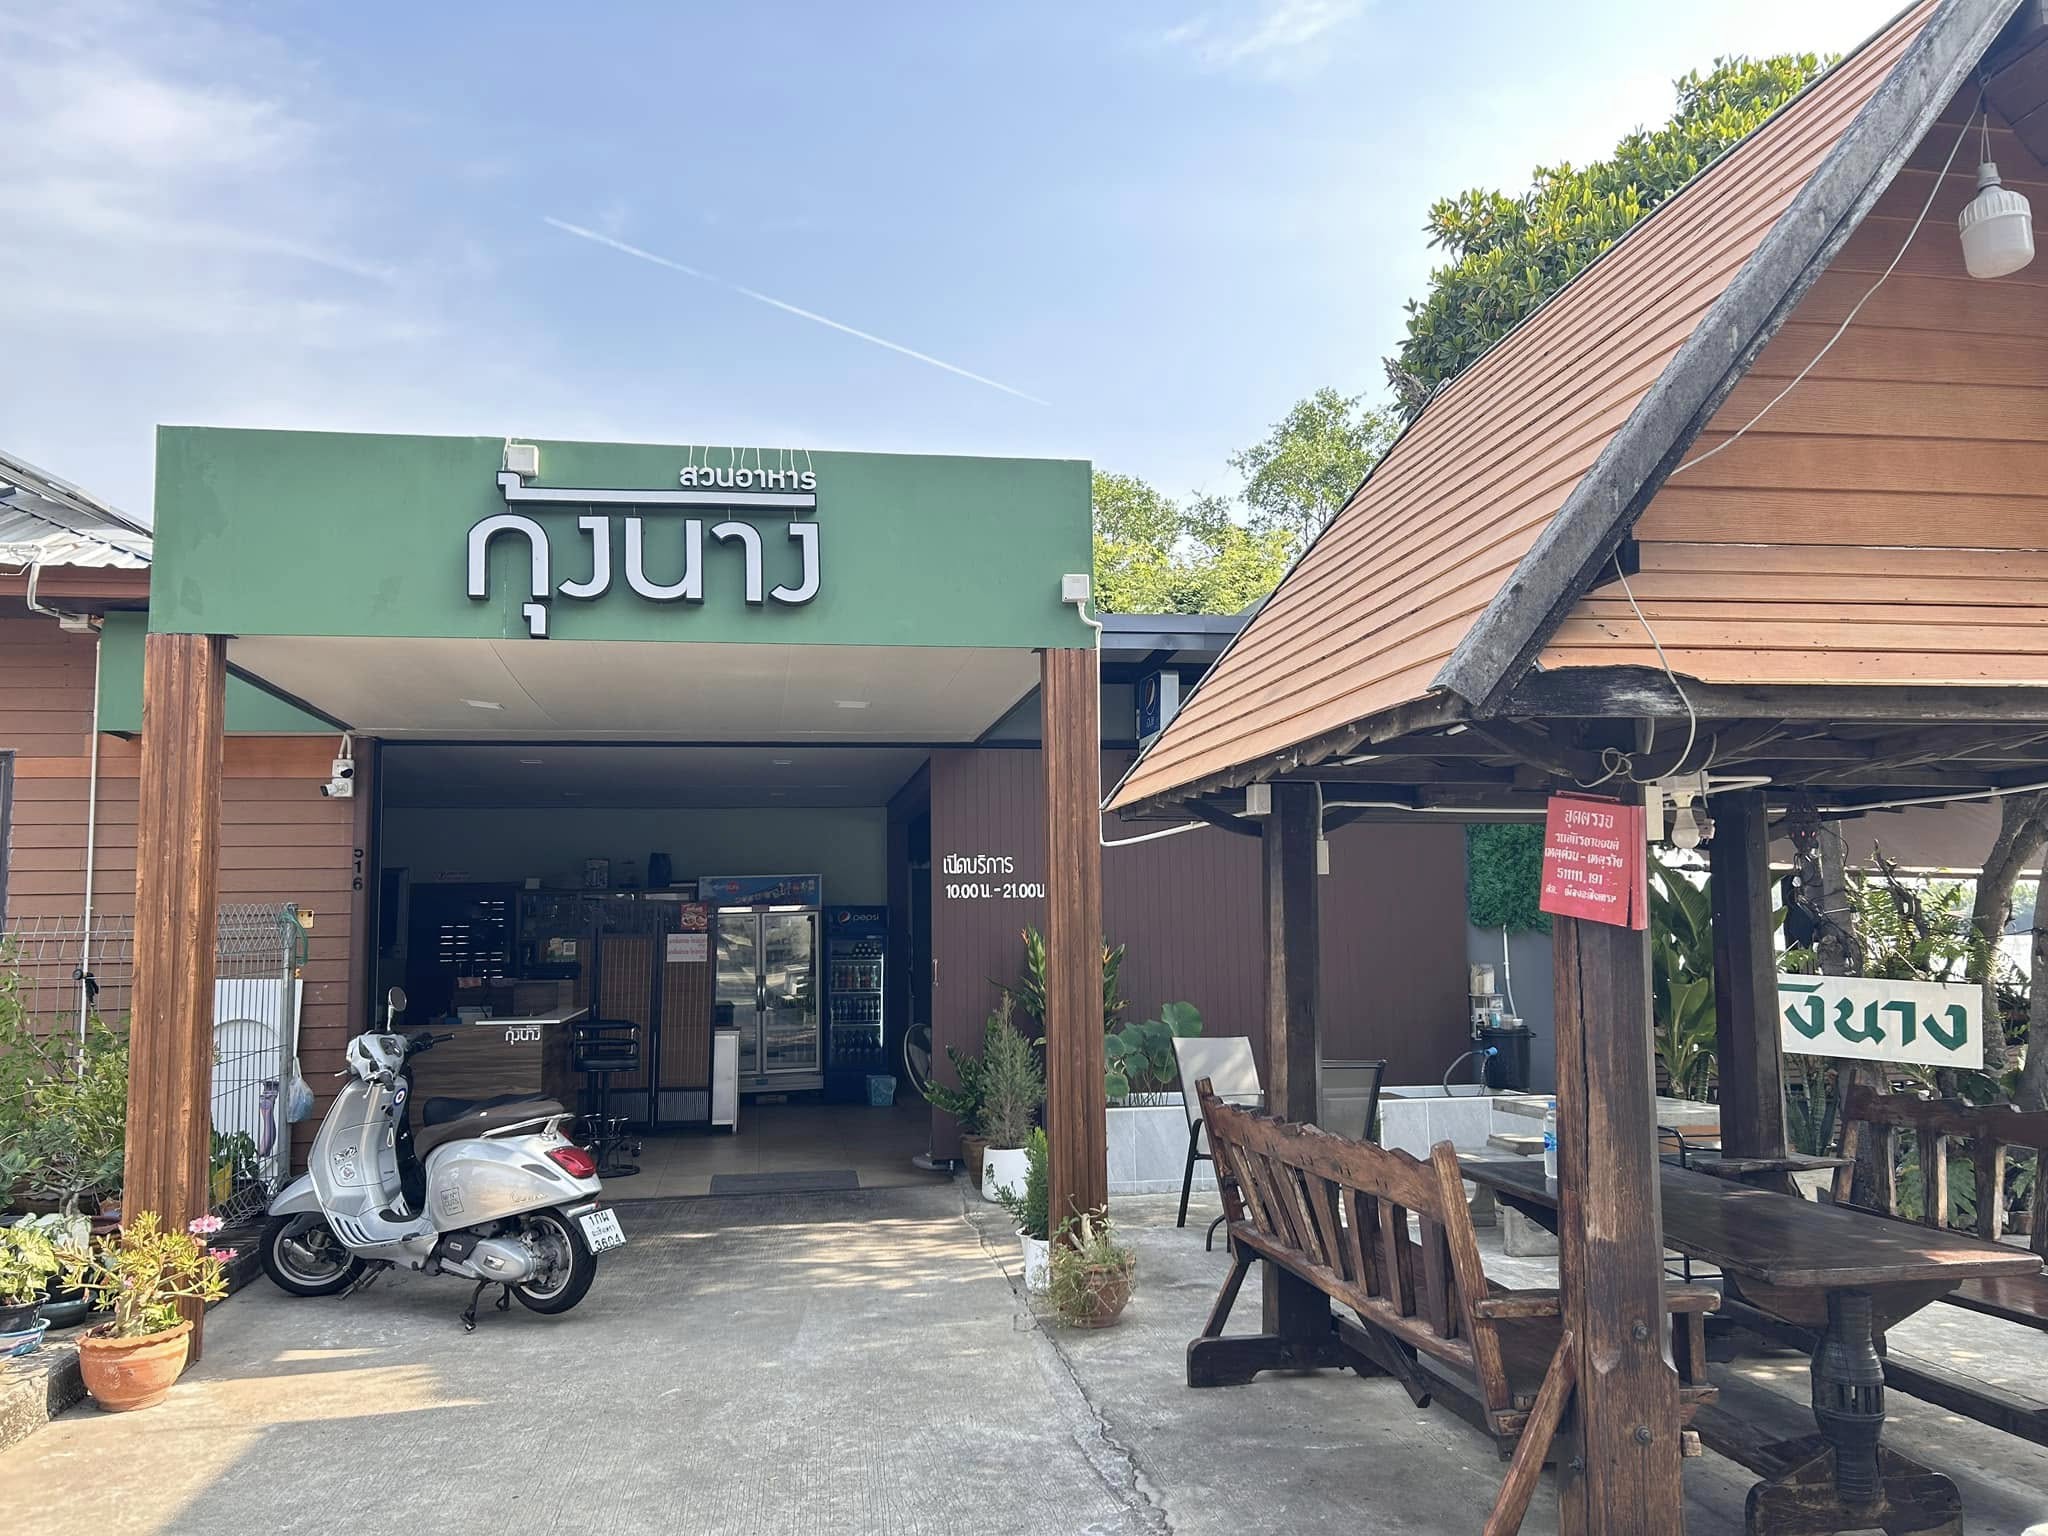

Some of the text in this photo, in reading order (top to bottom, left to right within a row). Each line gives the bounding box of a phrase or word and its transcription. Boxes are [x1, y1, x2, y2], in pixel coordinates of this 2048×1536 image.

[679, 465, 817, 490] สวนอาหาร
[467, 471, 821, 639] กุ้งนาง
[943, 853, 1014, 874] เปิดบริการ
[853, 912, 880, 923] pepsi
[594, 1233, 622, 1251] 3604
